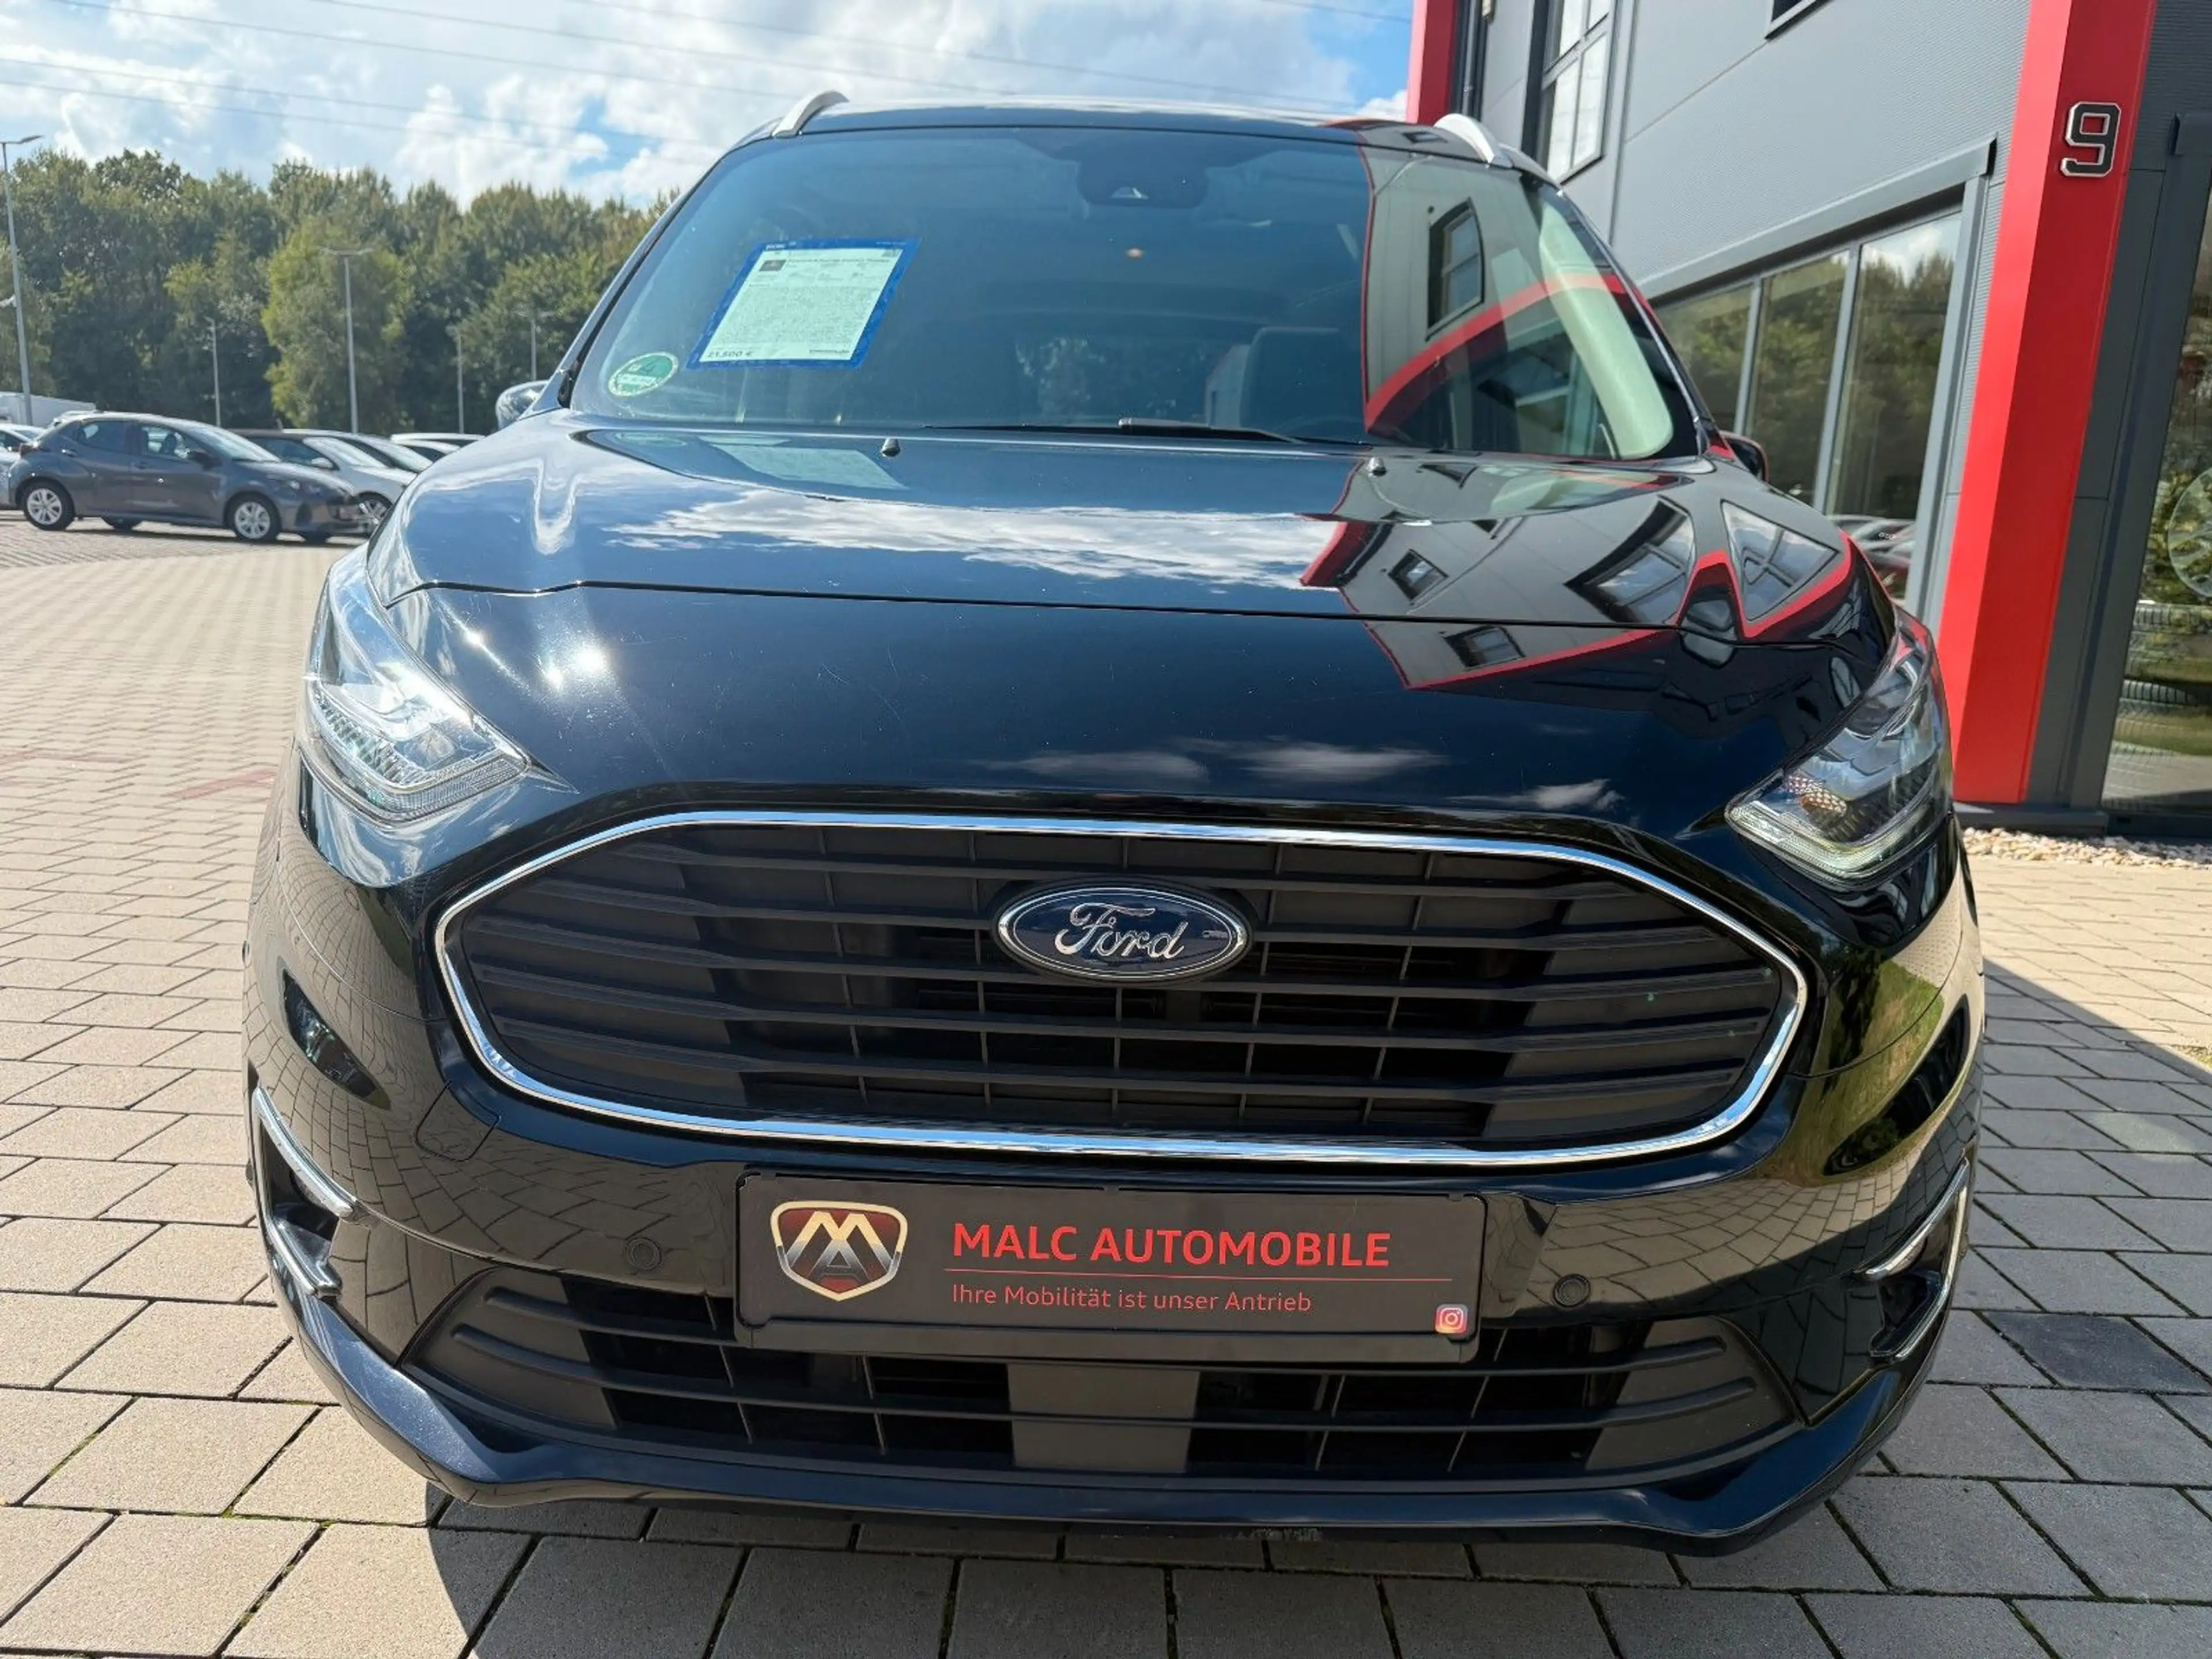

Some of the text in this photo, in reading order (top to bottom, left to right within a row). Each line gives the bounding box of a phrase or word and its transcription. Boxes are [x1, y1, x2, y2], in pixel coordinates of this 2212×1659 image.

[2061, 101, 2121, 177] 9
[1055, 902, 1189, 959] Ford
[953, 1222, 1391, 1267] MALC AUTOMOBILE
[953, 1283, 1312, 1311] Ihre Mobilität ist unser Antrieb
